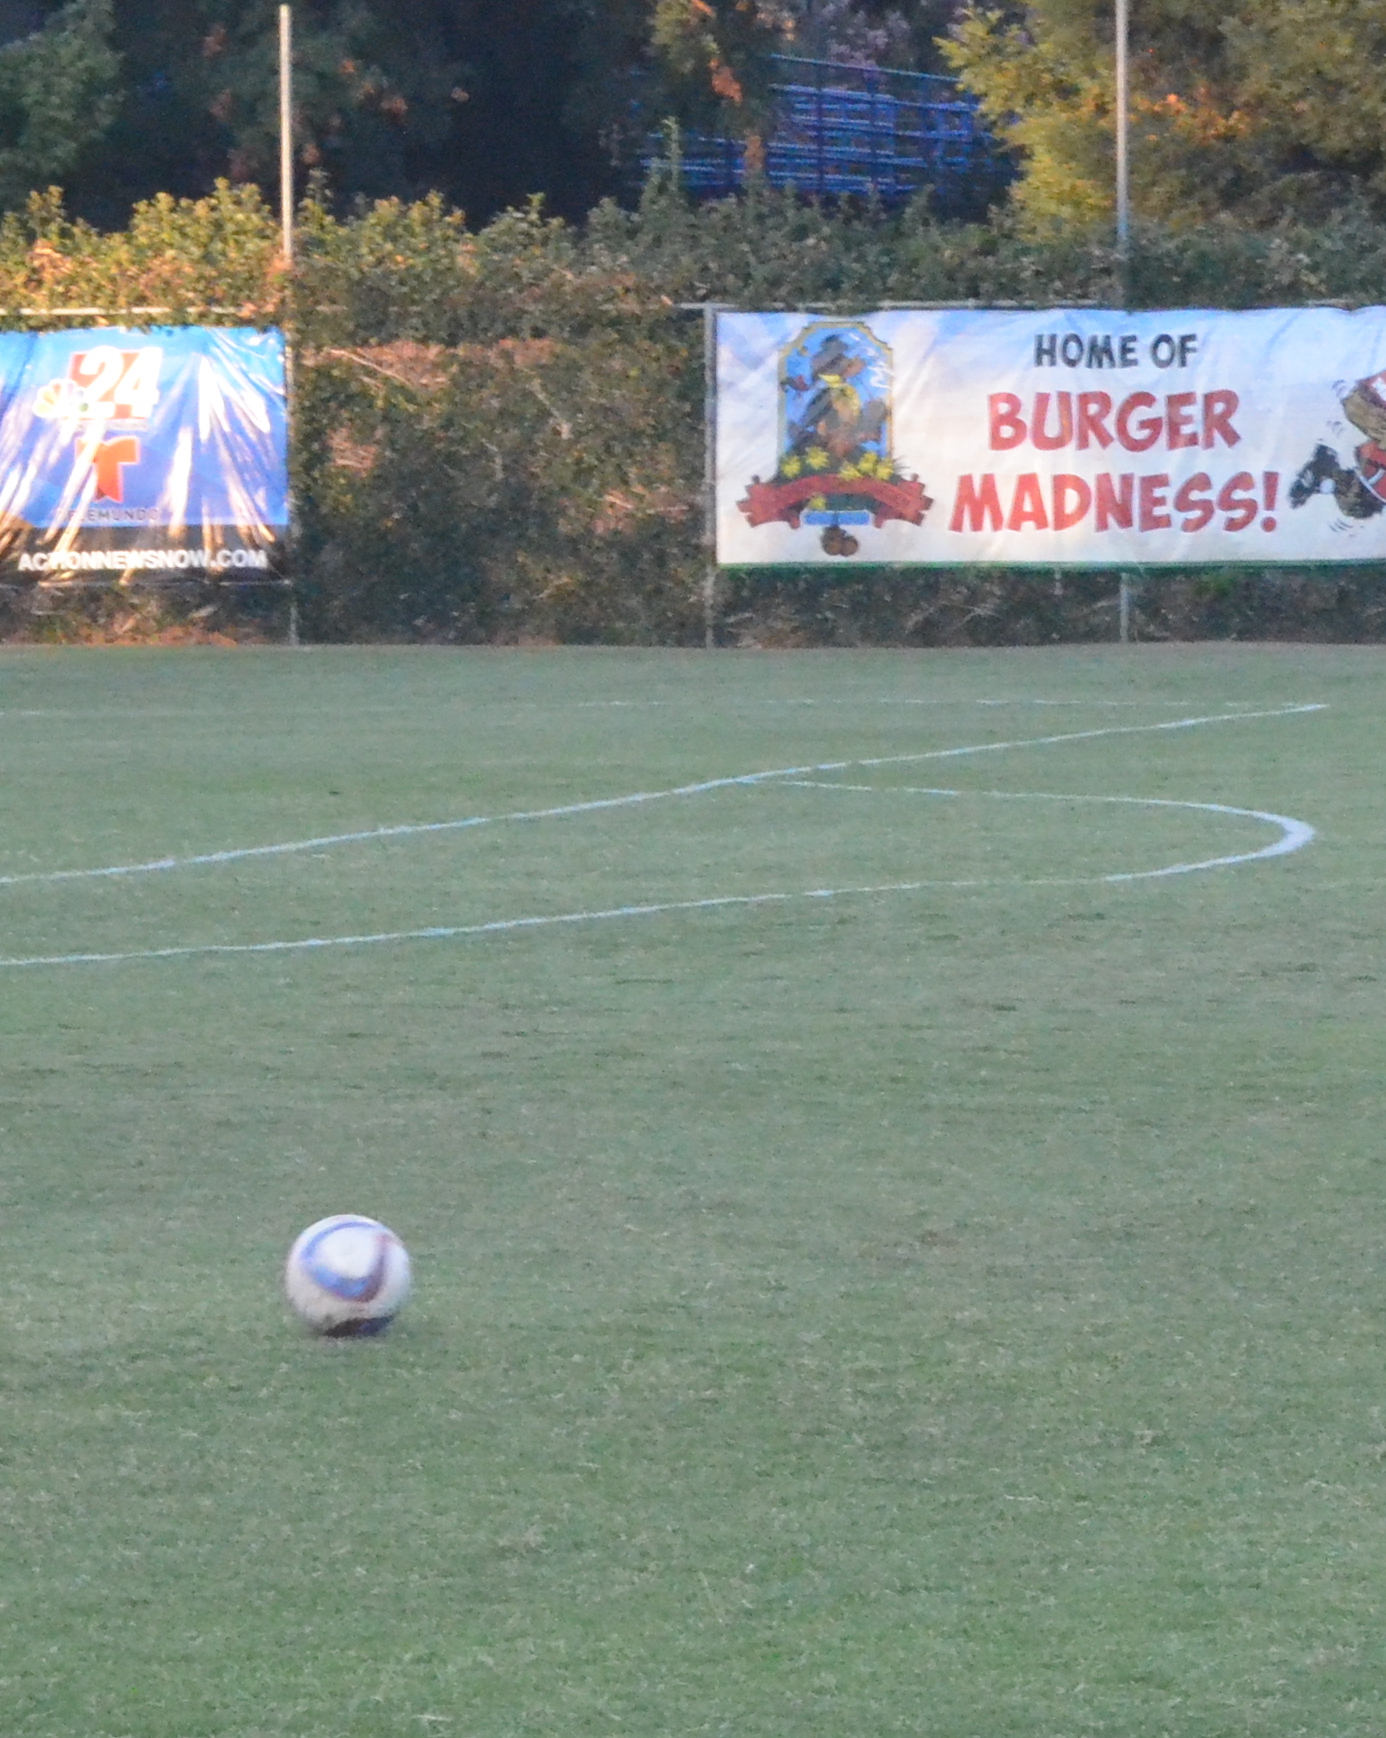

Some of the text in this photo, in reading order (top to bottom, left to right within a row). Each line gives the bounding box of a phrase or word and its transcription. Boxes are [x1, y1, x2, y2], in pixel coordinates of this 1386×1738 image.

[1034, 333, 1197, 369] HOME OF
[988, 390, 1242, 452] BURGER
[948, 471, 1280, 533] MADNESS!
